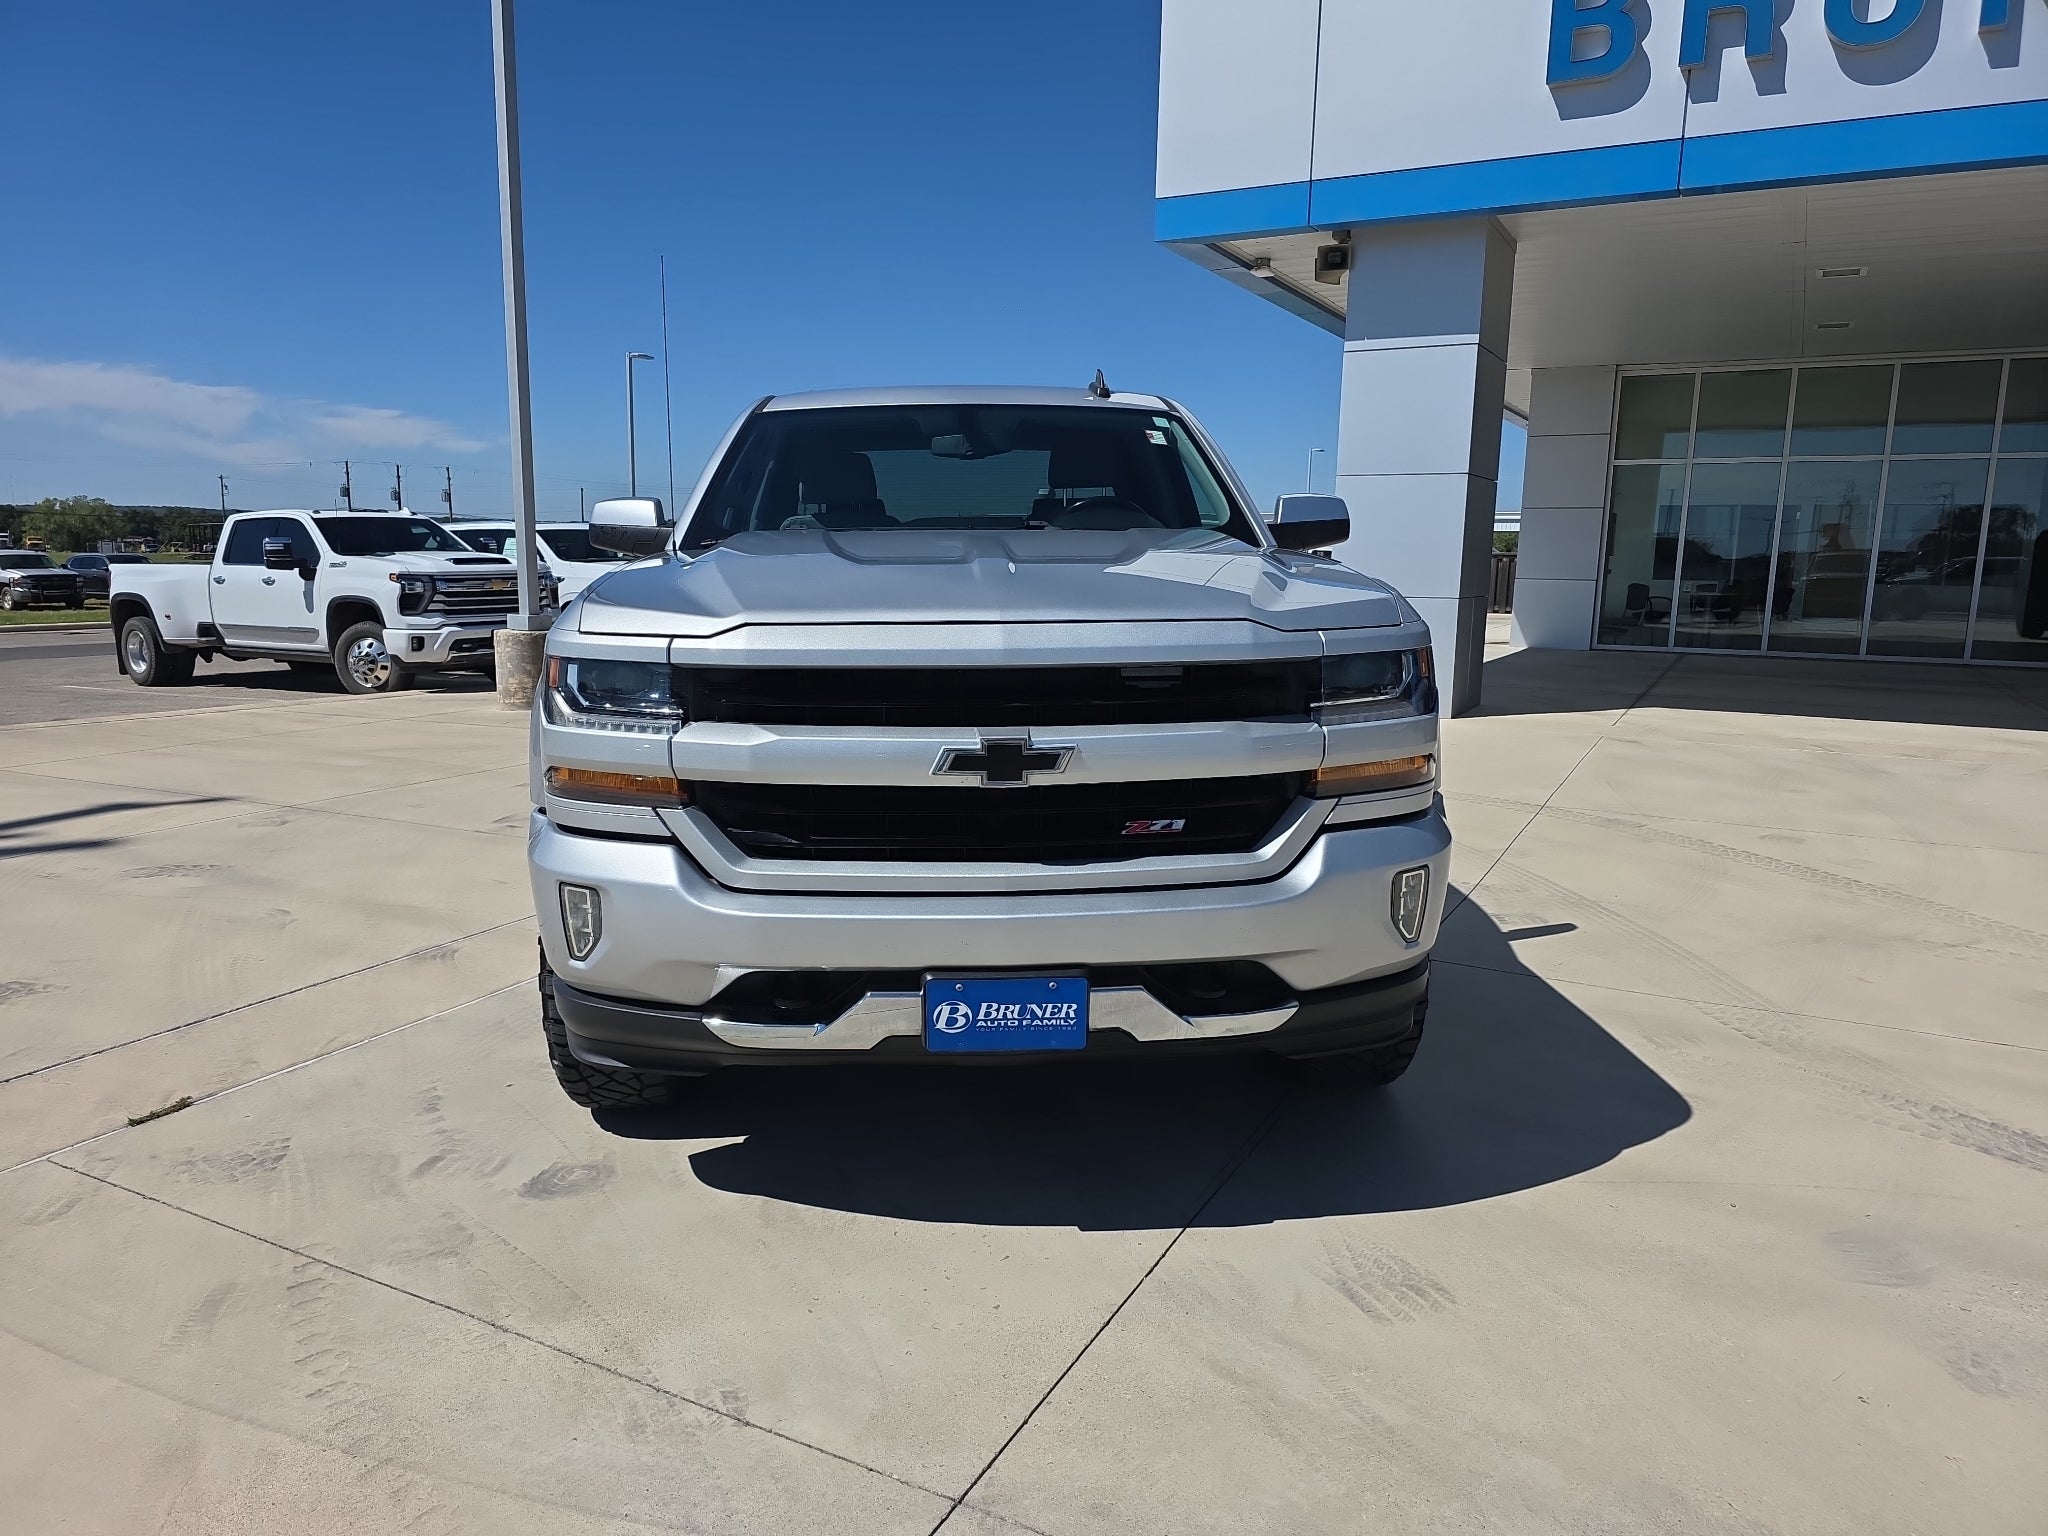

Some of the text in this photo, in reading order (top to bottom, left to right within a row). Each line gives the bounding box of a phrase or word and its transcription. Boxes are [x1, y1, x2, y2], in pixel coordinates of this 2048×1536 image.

[1121, 819, 1186, 834] Z71
[934, 1004, 968, 1029] B
[976, 1002, 1078, 1020] BRUNER
